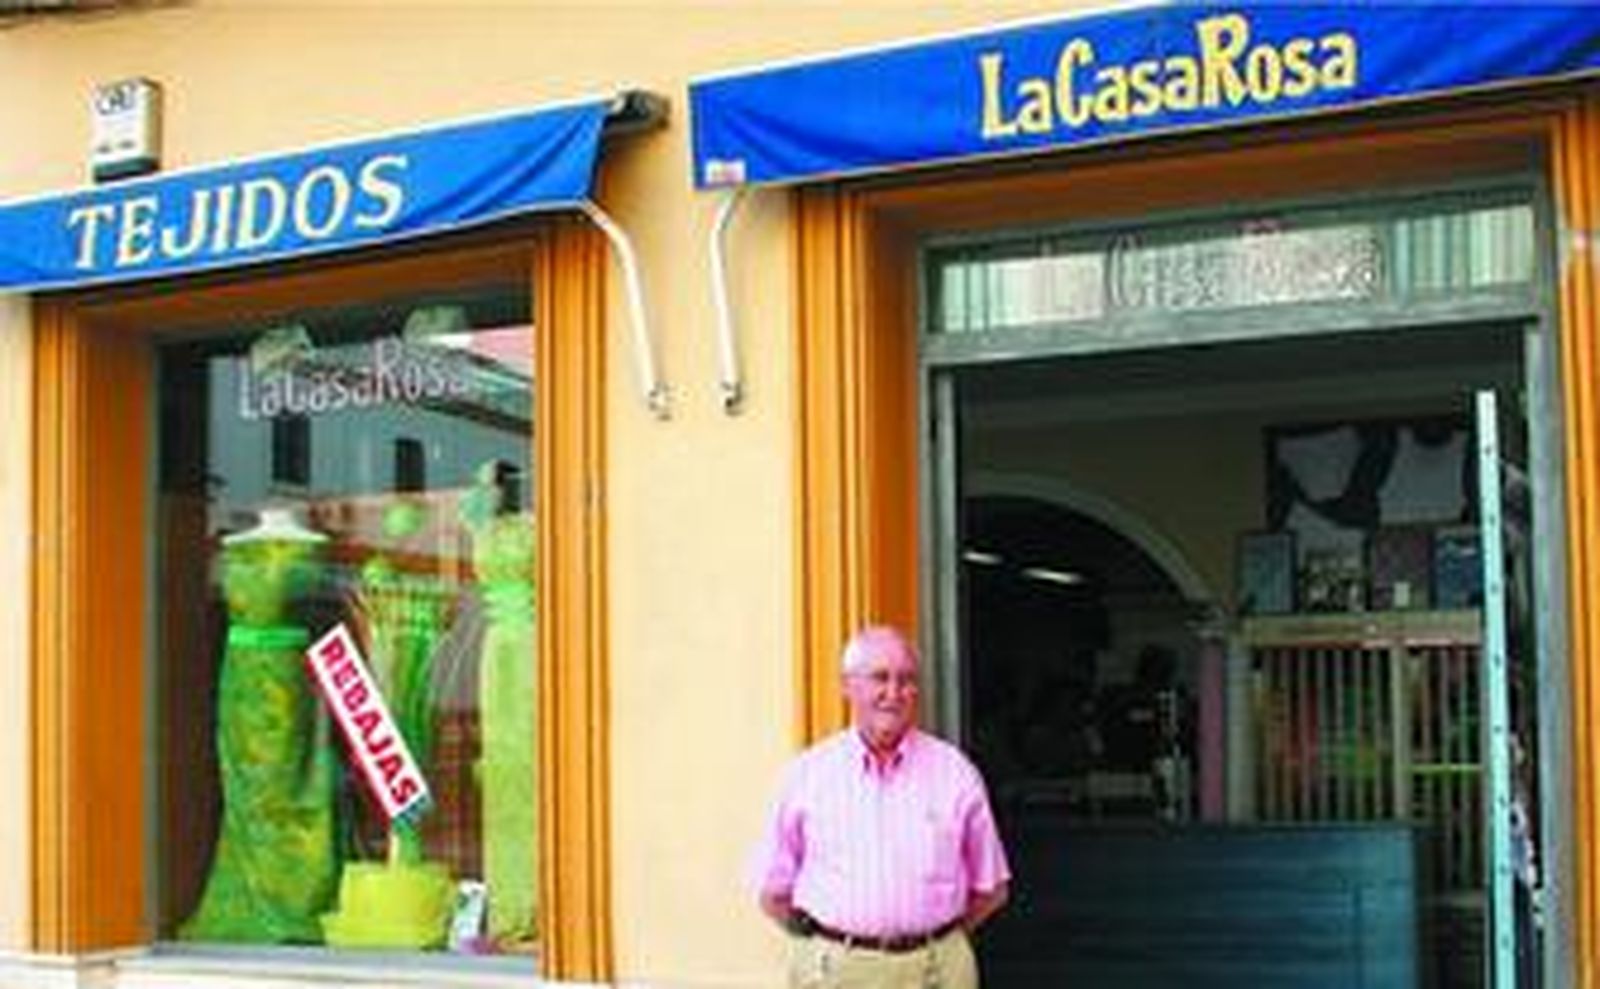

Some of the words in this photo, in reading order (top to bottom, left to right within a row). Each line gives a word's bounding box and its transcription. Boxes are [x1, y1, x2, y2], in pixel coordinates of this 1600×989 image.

[979, 13, 1357, 139] LaCasaRosa
[66, 154, 408, 269] TEJIDOS
[239, 335, 470, 419] LaCasaRosa
[319, 635, 420, 806] REBAJAS
